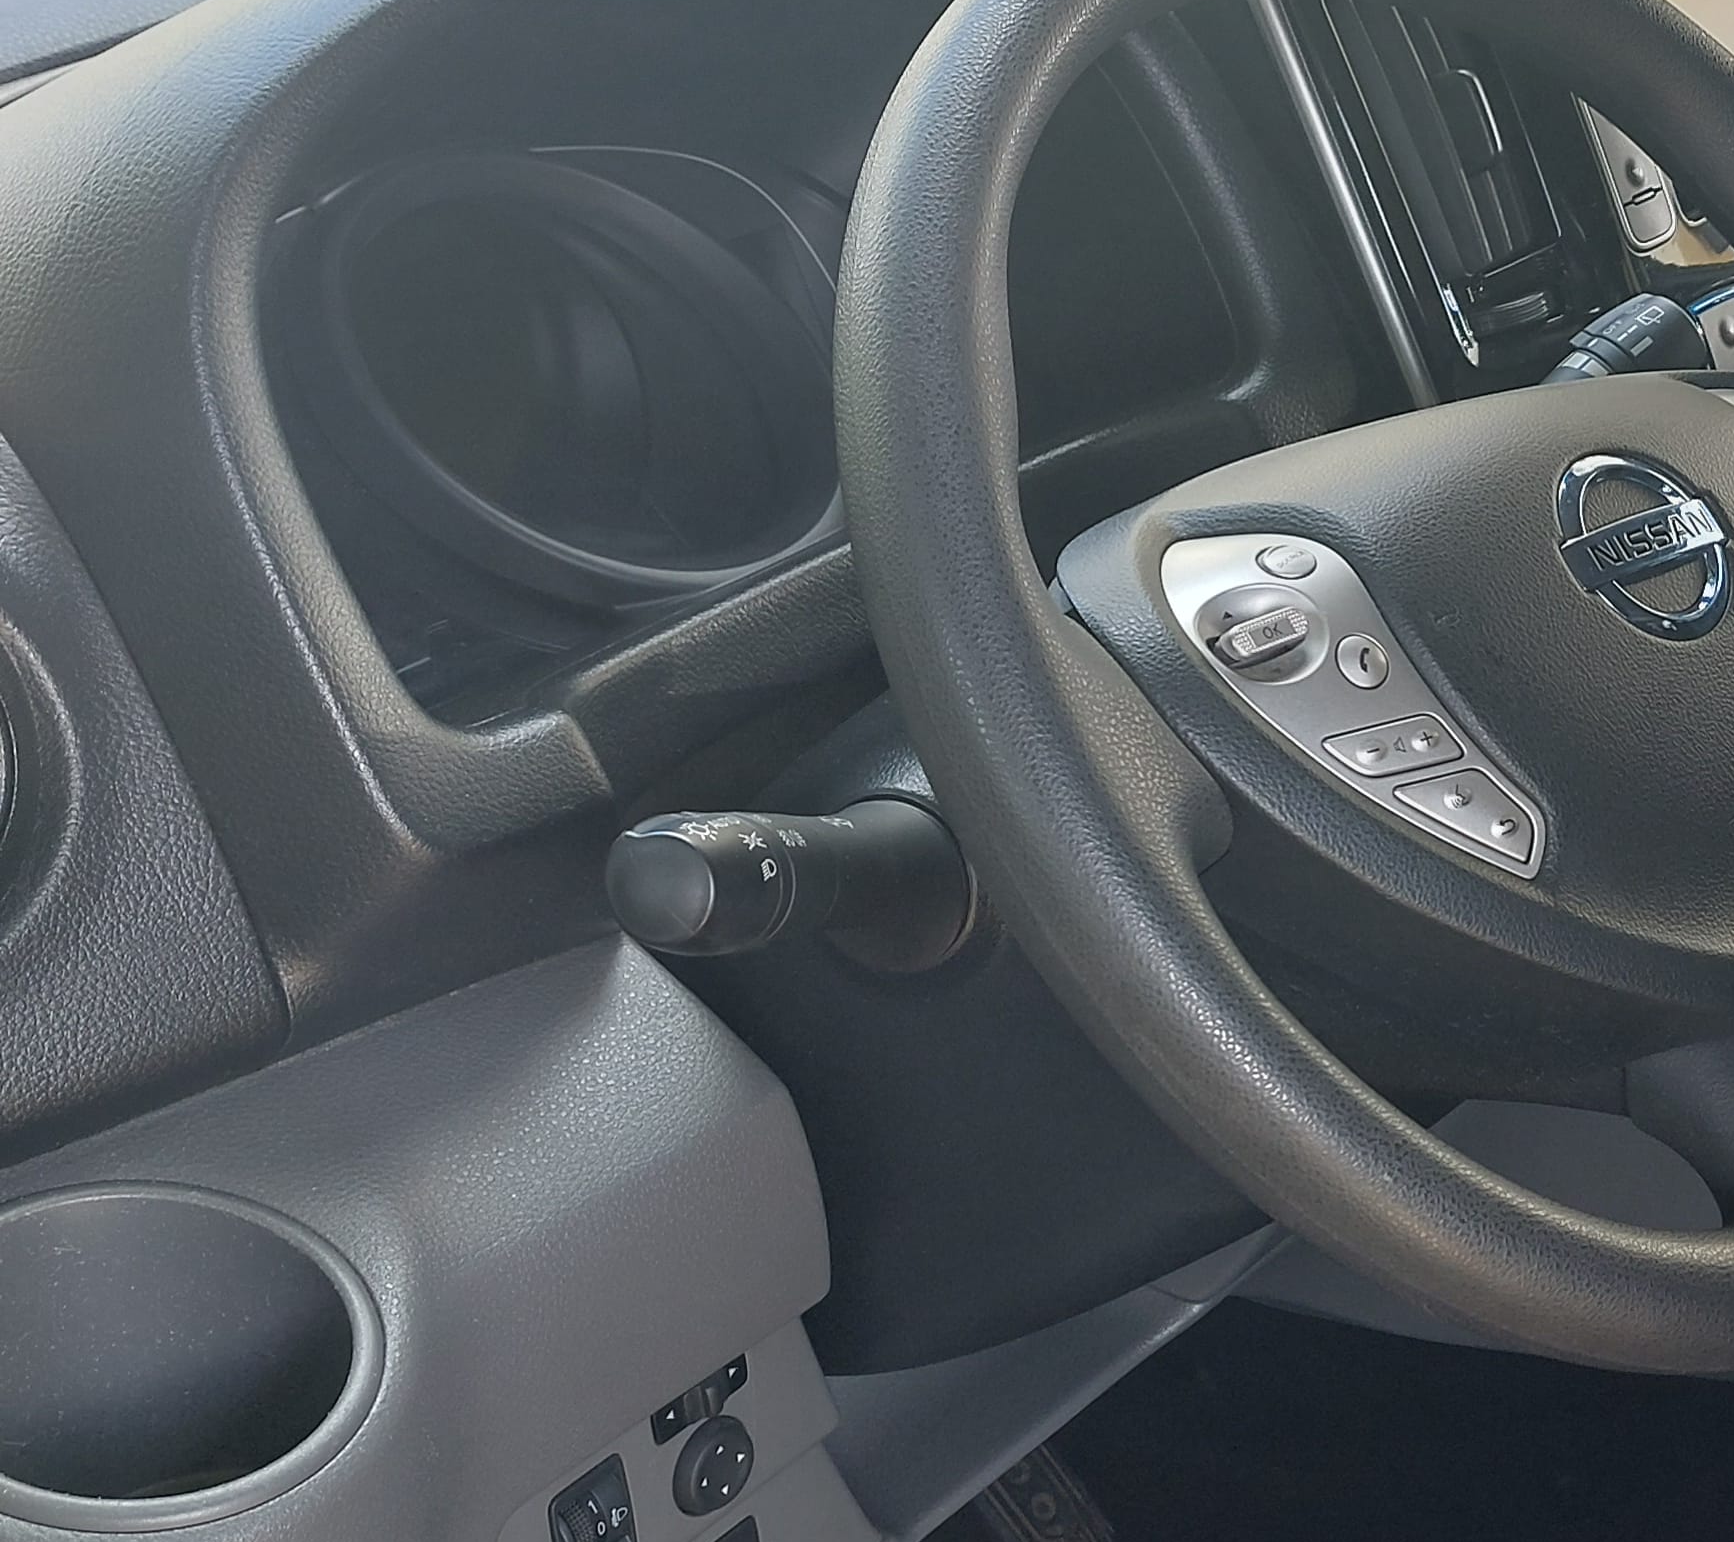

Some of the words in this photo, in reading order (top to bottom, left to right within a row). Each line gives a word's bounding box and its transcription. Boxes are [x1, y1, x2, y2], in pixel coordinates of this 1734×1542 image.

[1587, 508, 1715, 572] NISSAN
[1262, 624, 1282, 639] OK
[586, 1498, 600, 1515] 1
[596, 1520, 607, 1536] 0
